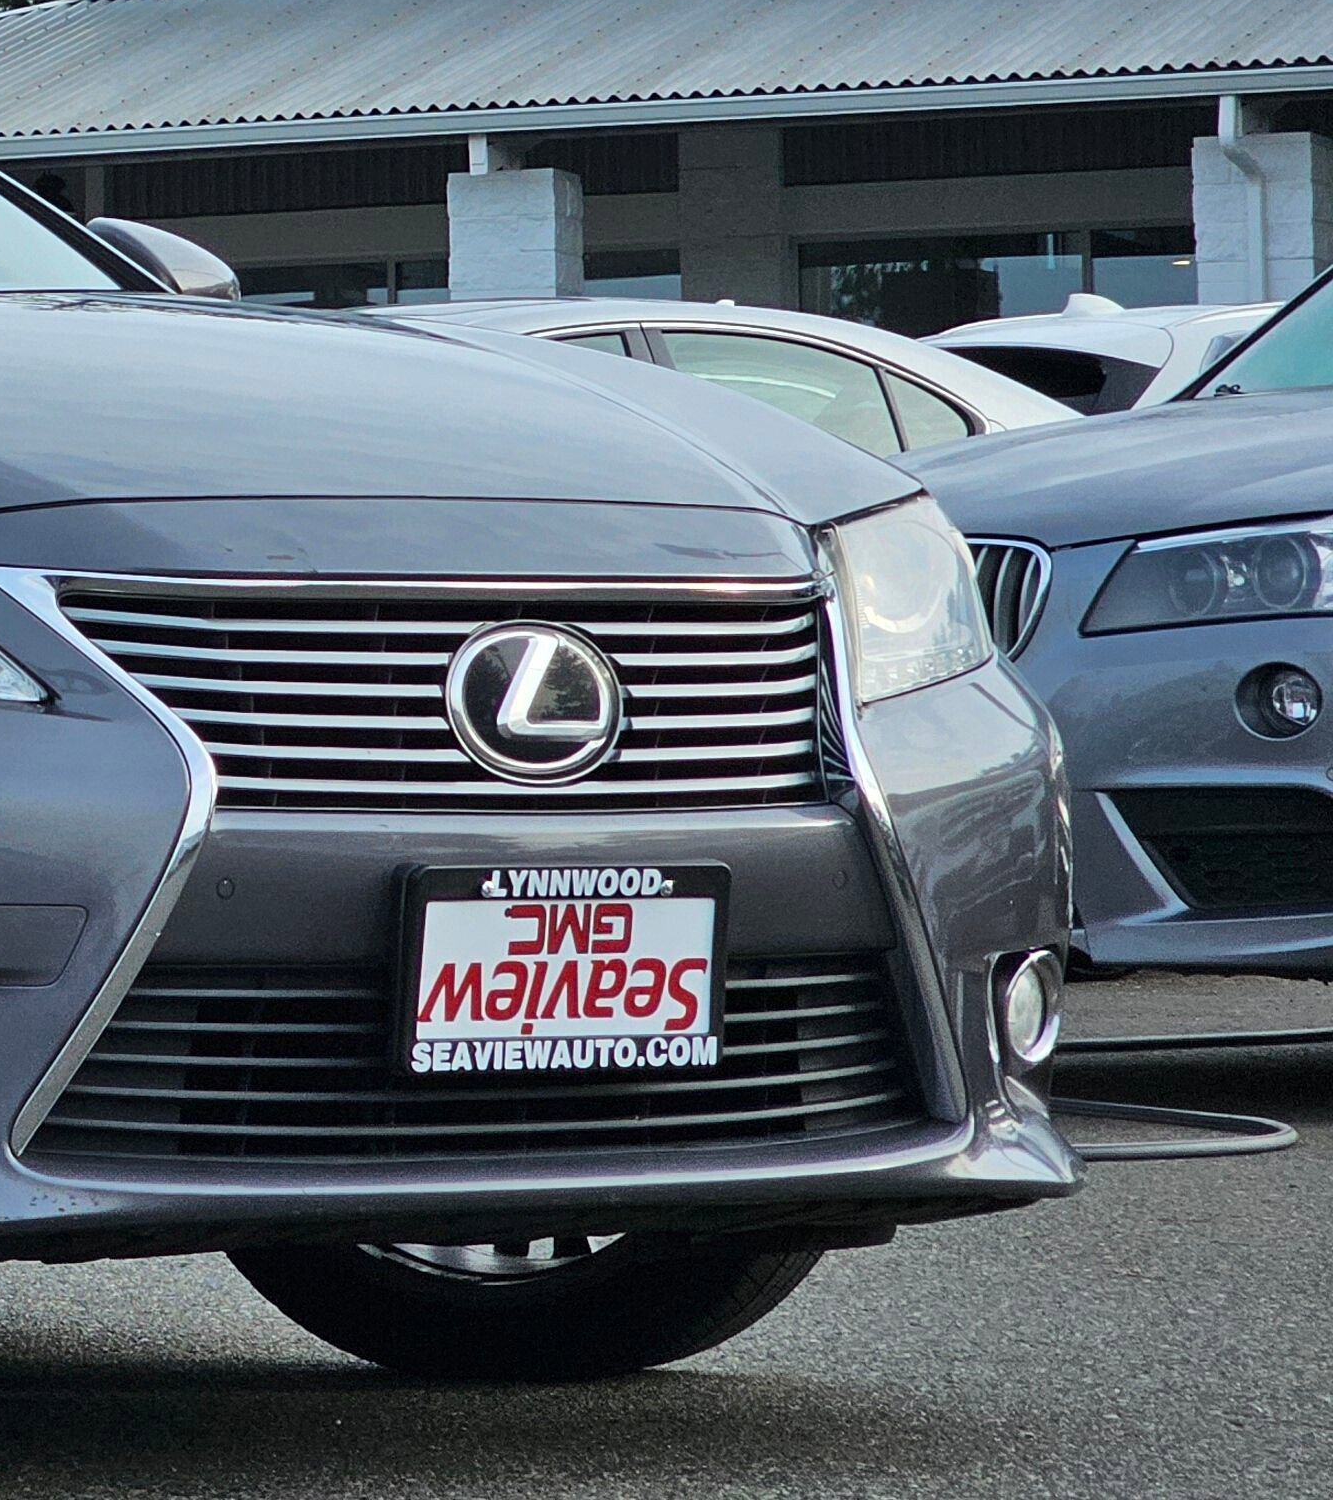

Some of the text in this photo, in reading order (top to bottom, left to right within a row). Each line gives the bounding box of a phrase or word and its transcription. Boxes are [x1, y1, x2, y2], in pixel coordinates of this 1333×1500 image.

[492, 868, 663, 898] LYNNWOOD
[504, 903, 633, 956] GMC
[417, 958, 709, 1035] Seaview
[411, 1036, 719, 1073] SEAVIEWAUTO.COM
